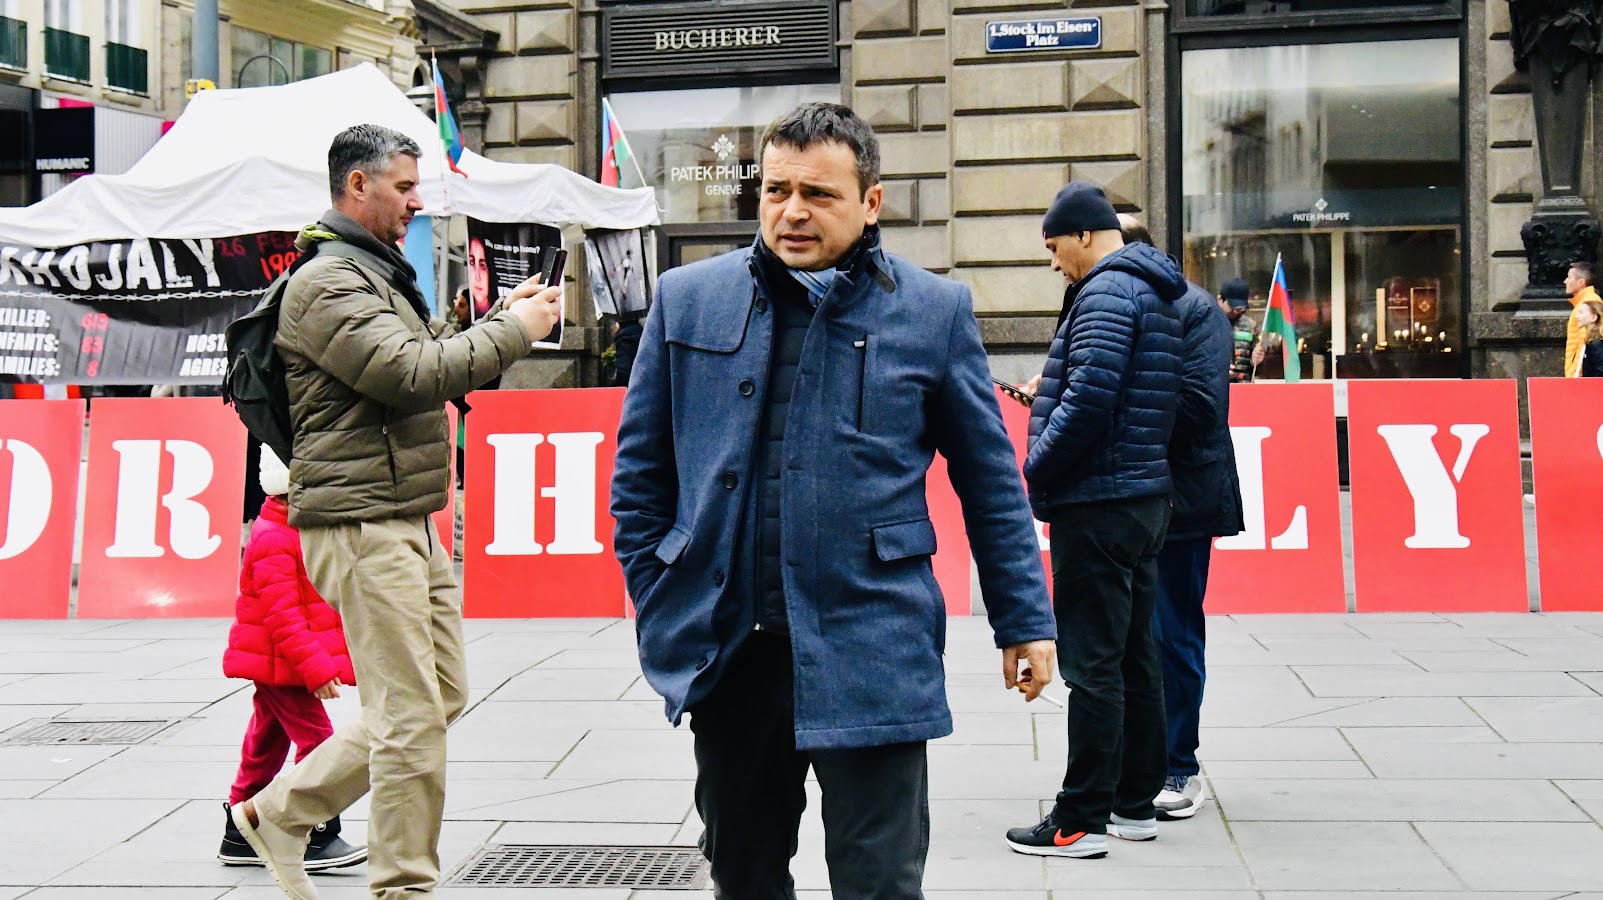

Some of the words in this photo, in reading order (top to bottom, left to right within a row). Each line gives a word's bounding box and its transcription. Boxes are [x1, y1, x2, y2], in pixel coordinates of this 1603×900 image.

[1036, 23, 1055, 34] im
[655, 26, 780, 50] BUCHERER
[1025, 34, 1059, 47] Platz
[36, 157, 90, 170] HUMANIC
[671, 166, 713, 181] PATEK
[705, 184, 743, 195] GENEVE
[1292, 213, 1316, 221] PATEK
[1316, 212, 1350, 221] PHILIPPE
[0, 238, 221, 291] KHOJALY
[260, 250, 304, 283] 199
